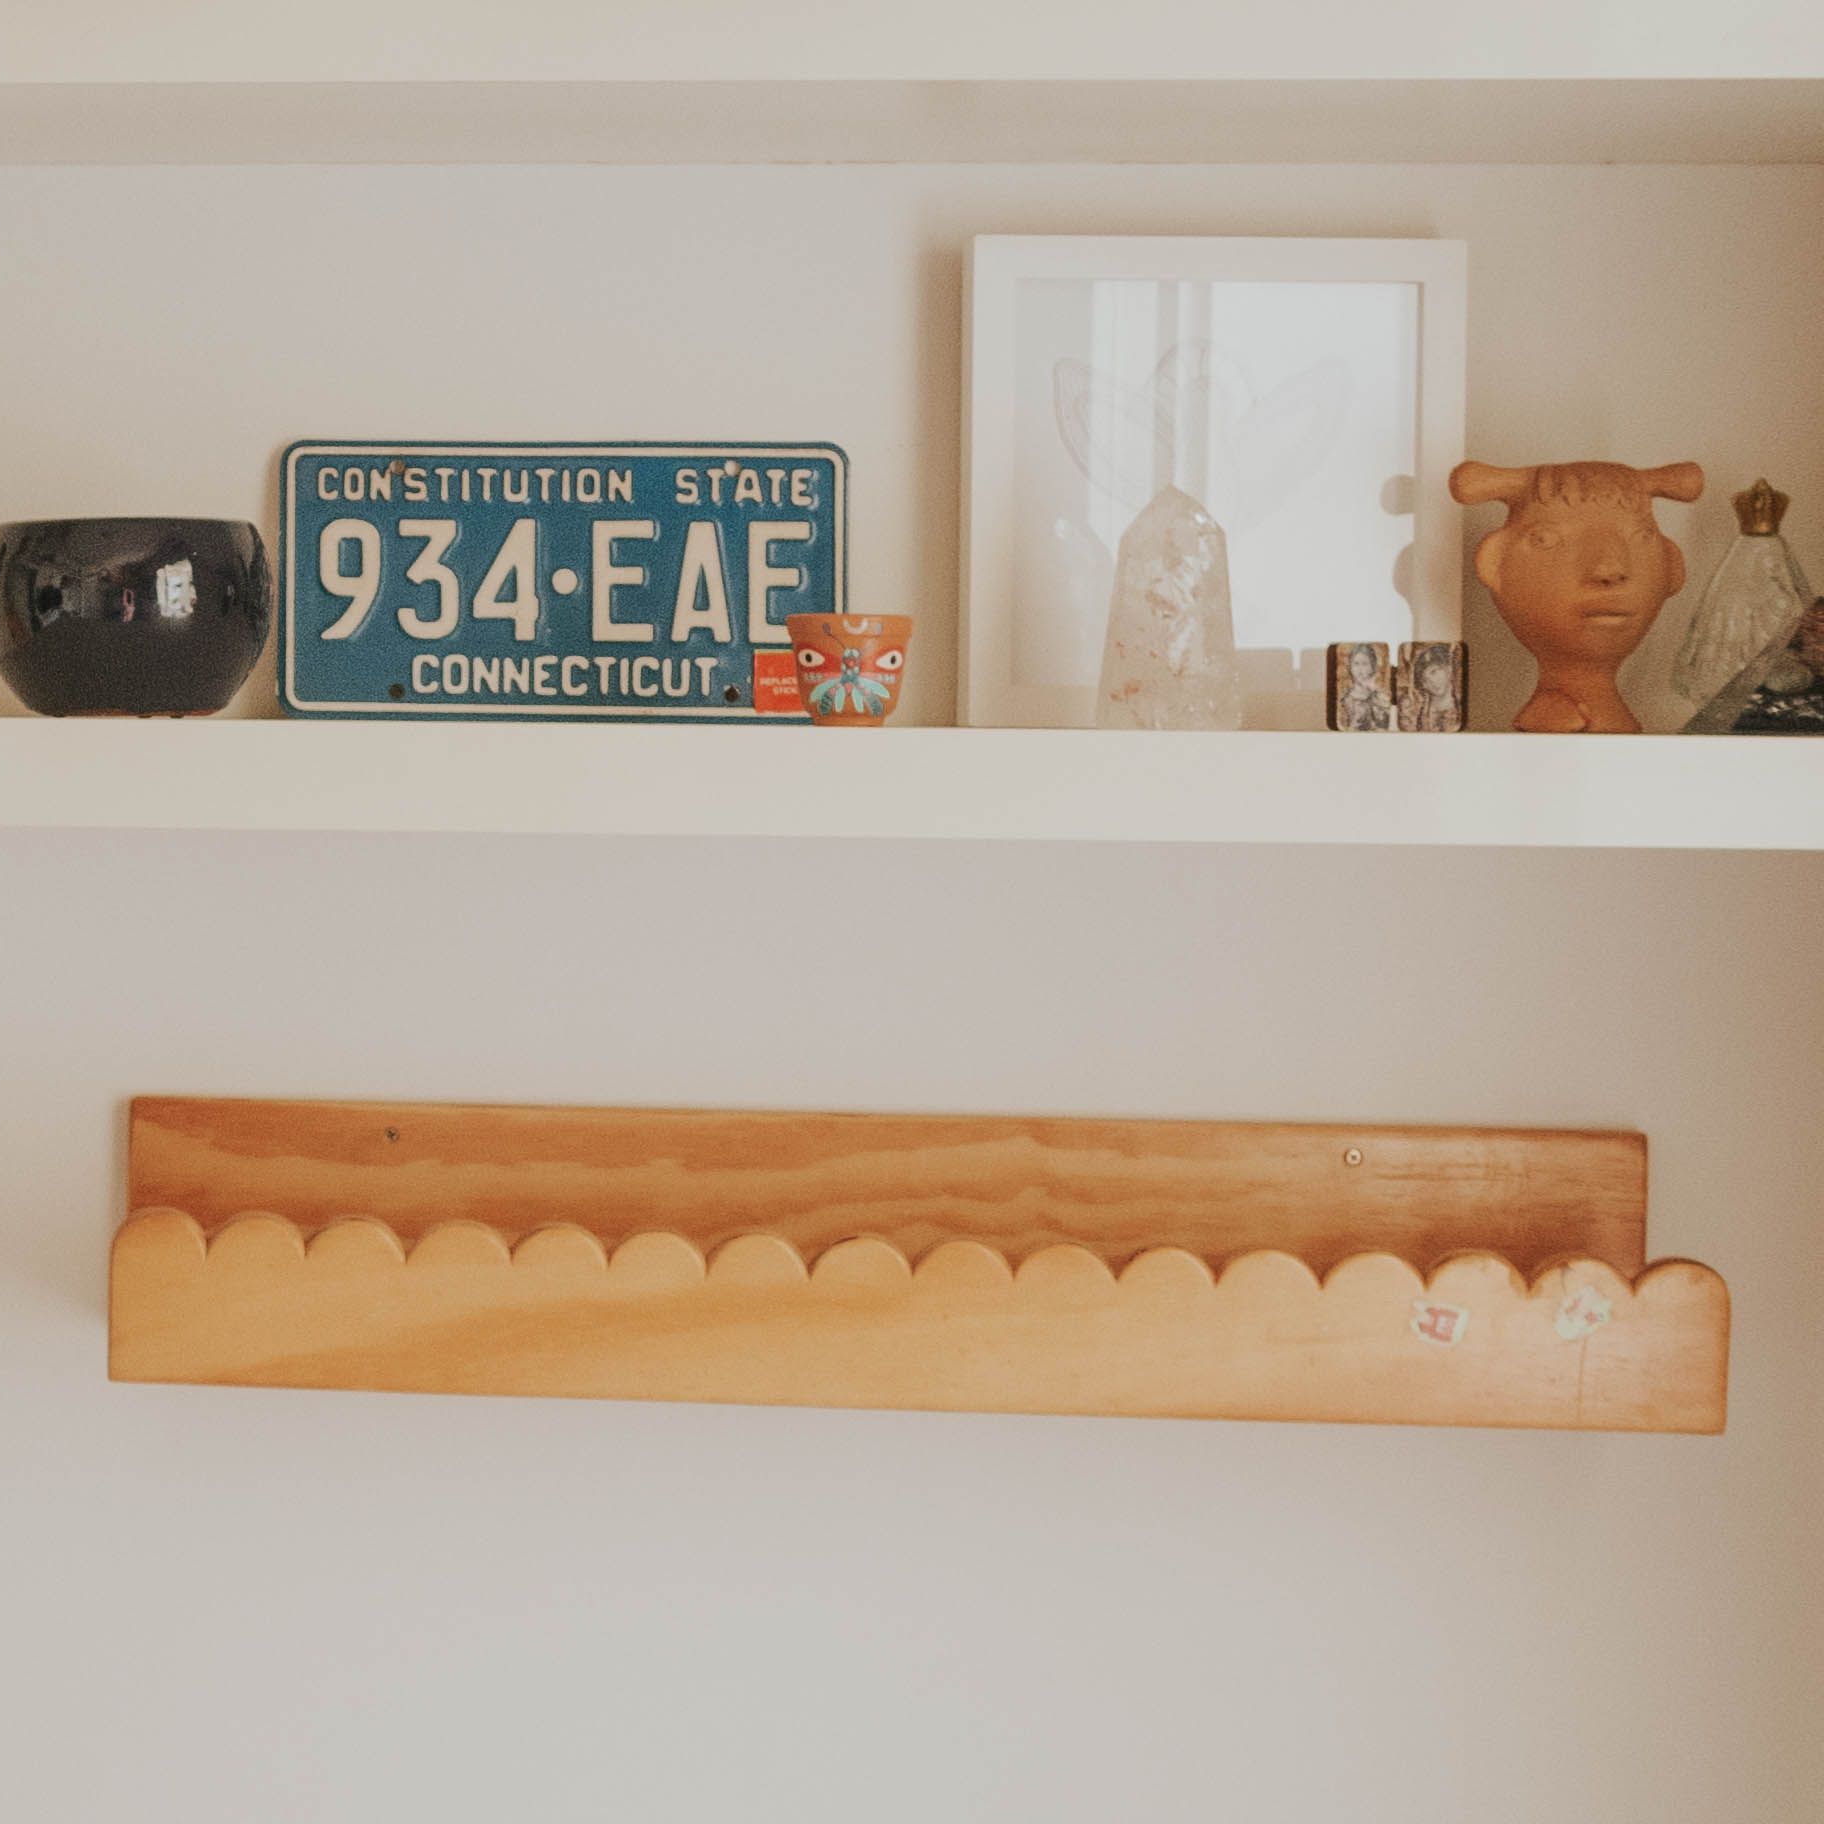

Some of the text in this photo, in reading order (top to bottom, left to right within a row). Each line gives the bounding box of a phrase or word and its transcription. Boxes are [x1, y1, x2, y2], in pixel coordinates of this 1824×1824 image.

[318, 467, 815, 507] CONSTITUTION STATE
[412, 654, 719, 697] CONNECTICUT
